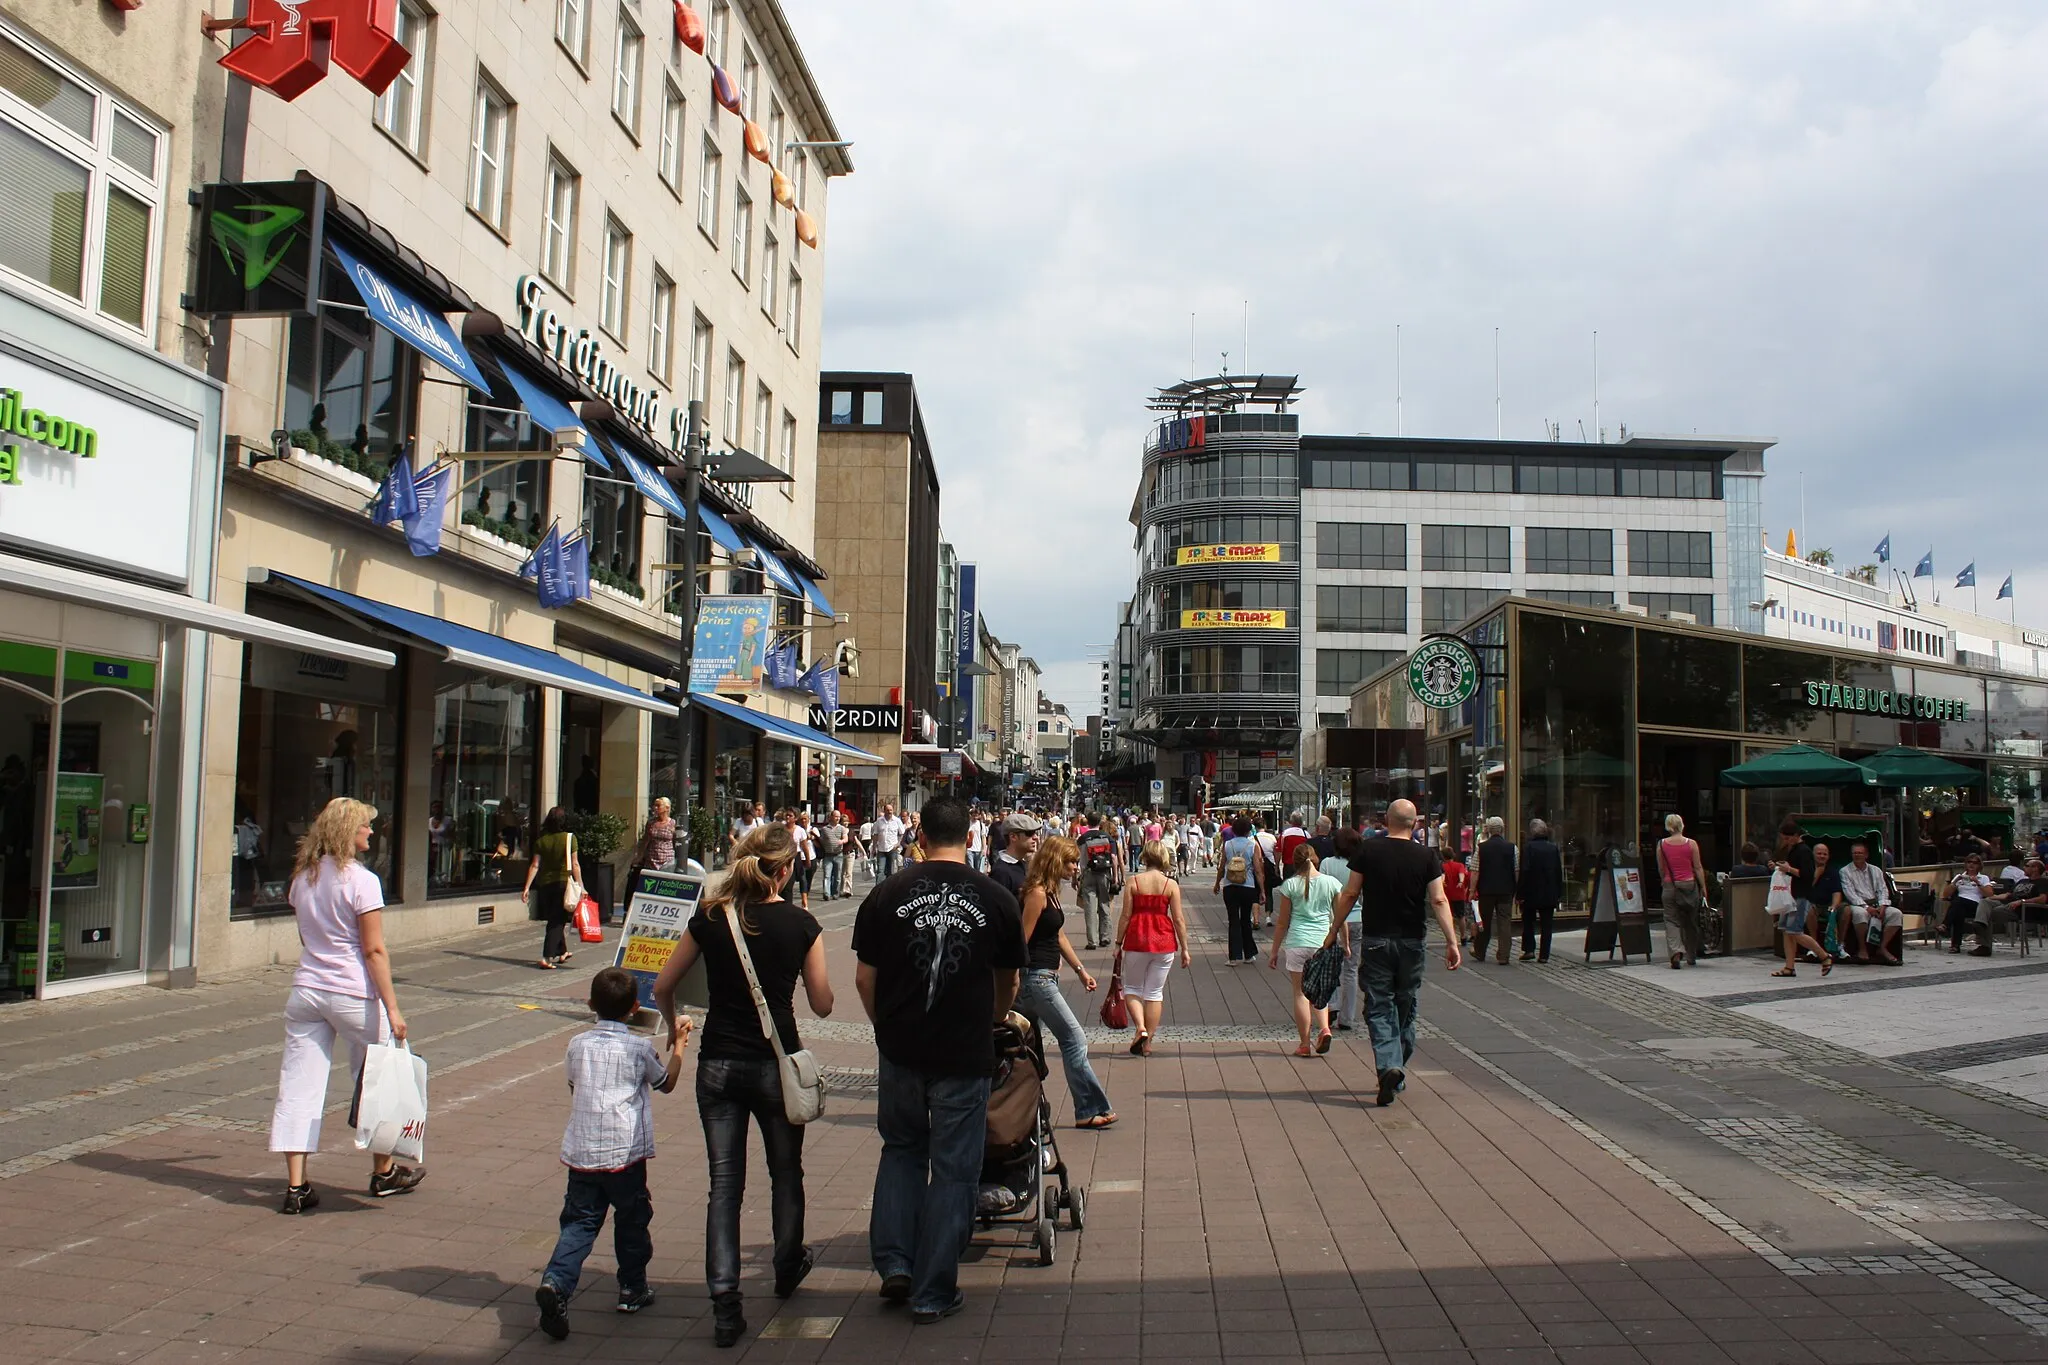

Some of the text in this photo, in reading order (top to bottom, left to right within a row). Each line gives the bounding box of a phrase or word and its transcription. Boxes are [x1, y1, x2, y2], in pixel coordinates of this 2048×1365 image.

[517, 274, 661, 433] Ferdinand
[0, 388, 97, 458] ilcom
[1229, 546, 1266, 556] MAX
[702, 605, 763, 615] Der Kleine
[1234, 612, 1272, 622] MAX
[700, 616, 731, 625] Prinz
[1412, 644, 1472, 673] STARBUCKS
[1418, 687, 1464, 706] COFFEE
[1807, 681, 1970, 722] STARBUCKS COFFEE
[1102, 661, 1110, 750] KARSTADT
[660, 880, 694, 891] mobilcom
[640, 903, 680, 918] 1&1 DSL
[896, 893, 987, 927] Orange County
[914, 909, 973, 933] Choppers
[626, 953, 639, 964] für
[629, 943, 672, 957] 6 Monate
